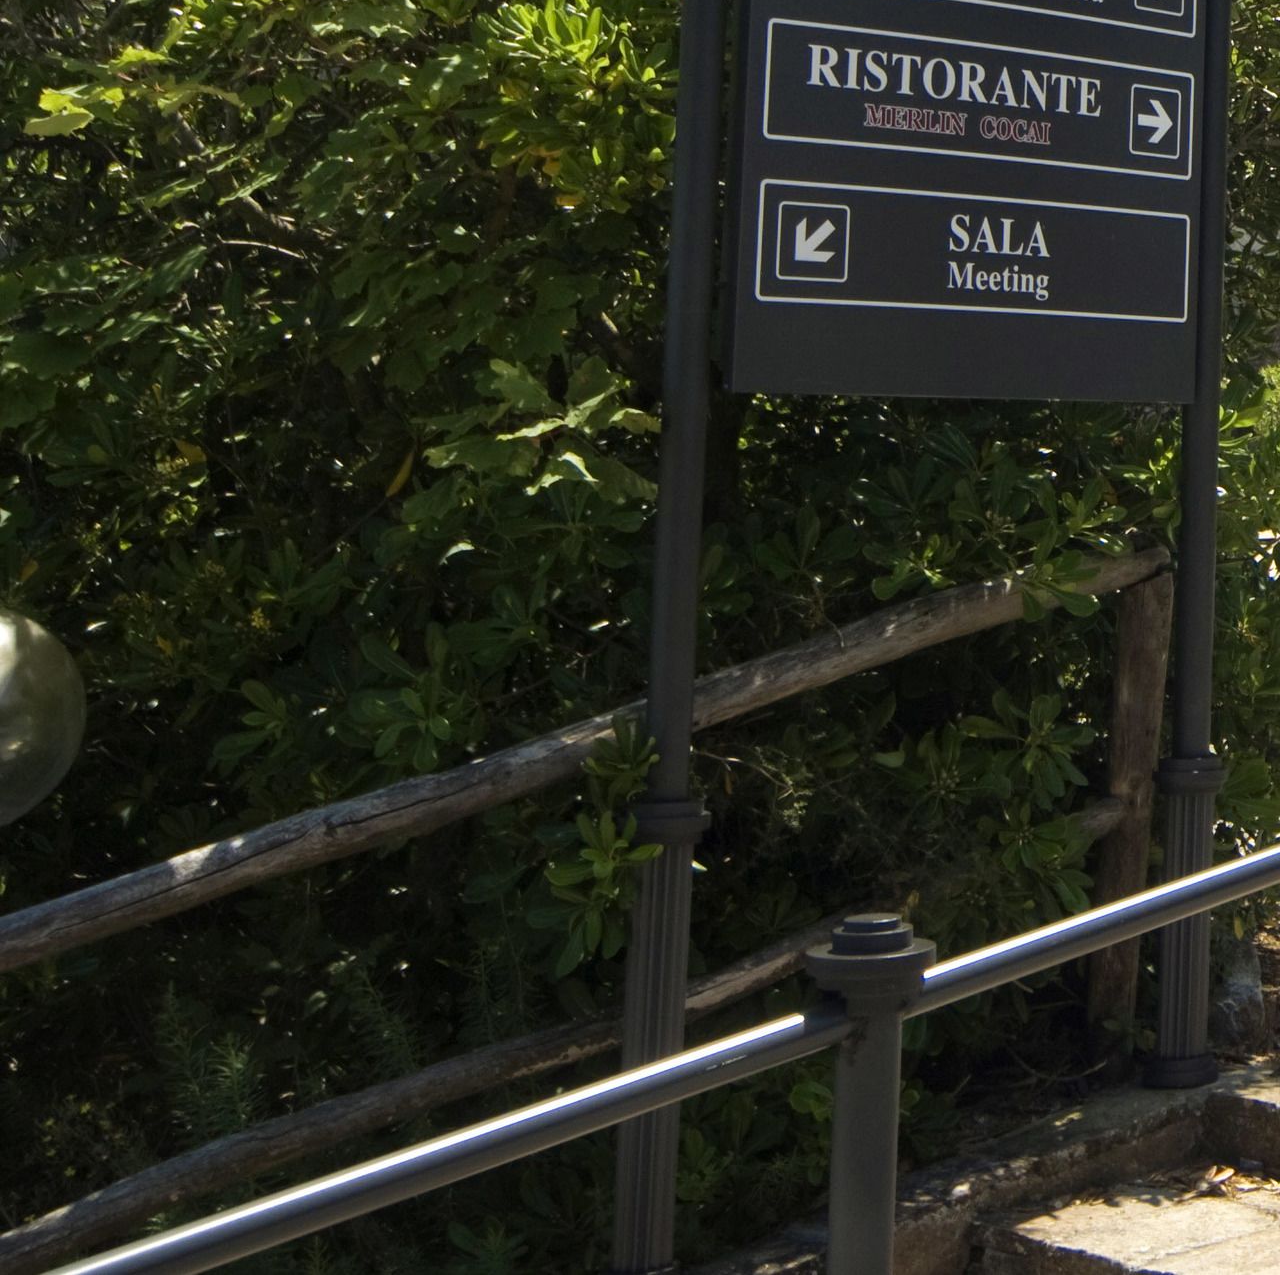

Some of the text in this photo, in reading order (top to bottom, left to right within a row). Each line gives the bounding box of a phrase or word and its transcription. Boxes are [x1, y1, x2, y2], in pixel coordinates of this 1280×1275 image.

[806, 43, 1102, 118] RISTORANTE
[863, 103, 1051, 145] MERLIN COCAI
[949, 213, 1051, 258] SALA
[947, 260, 1050, 301] Meeting
